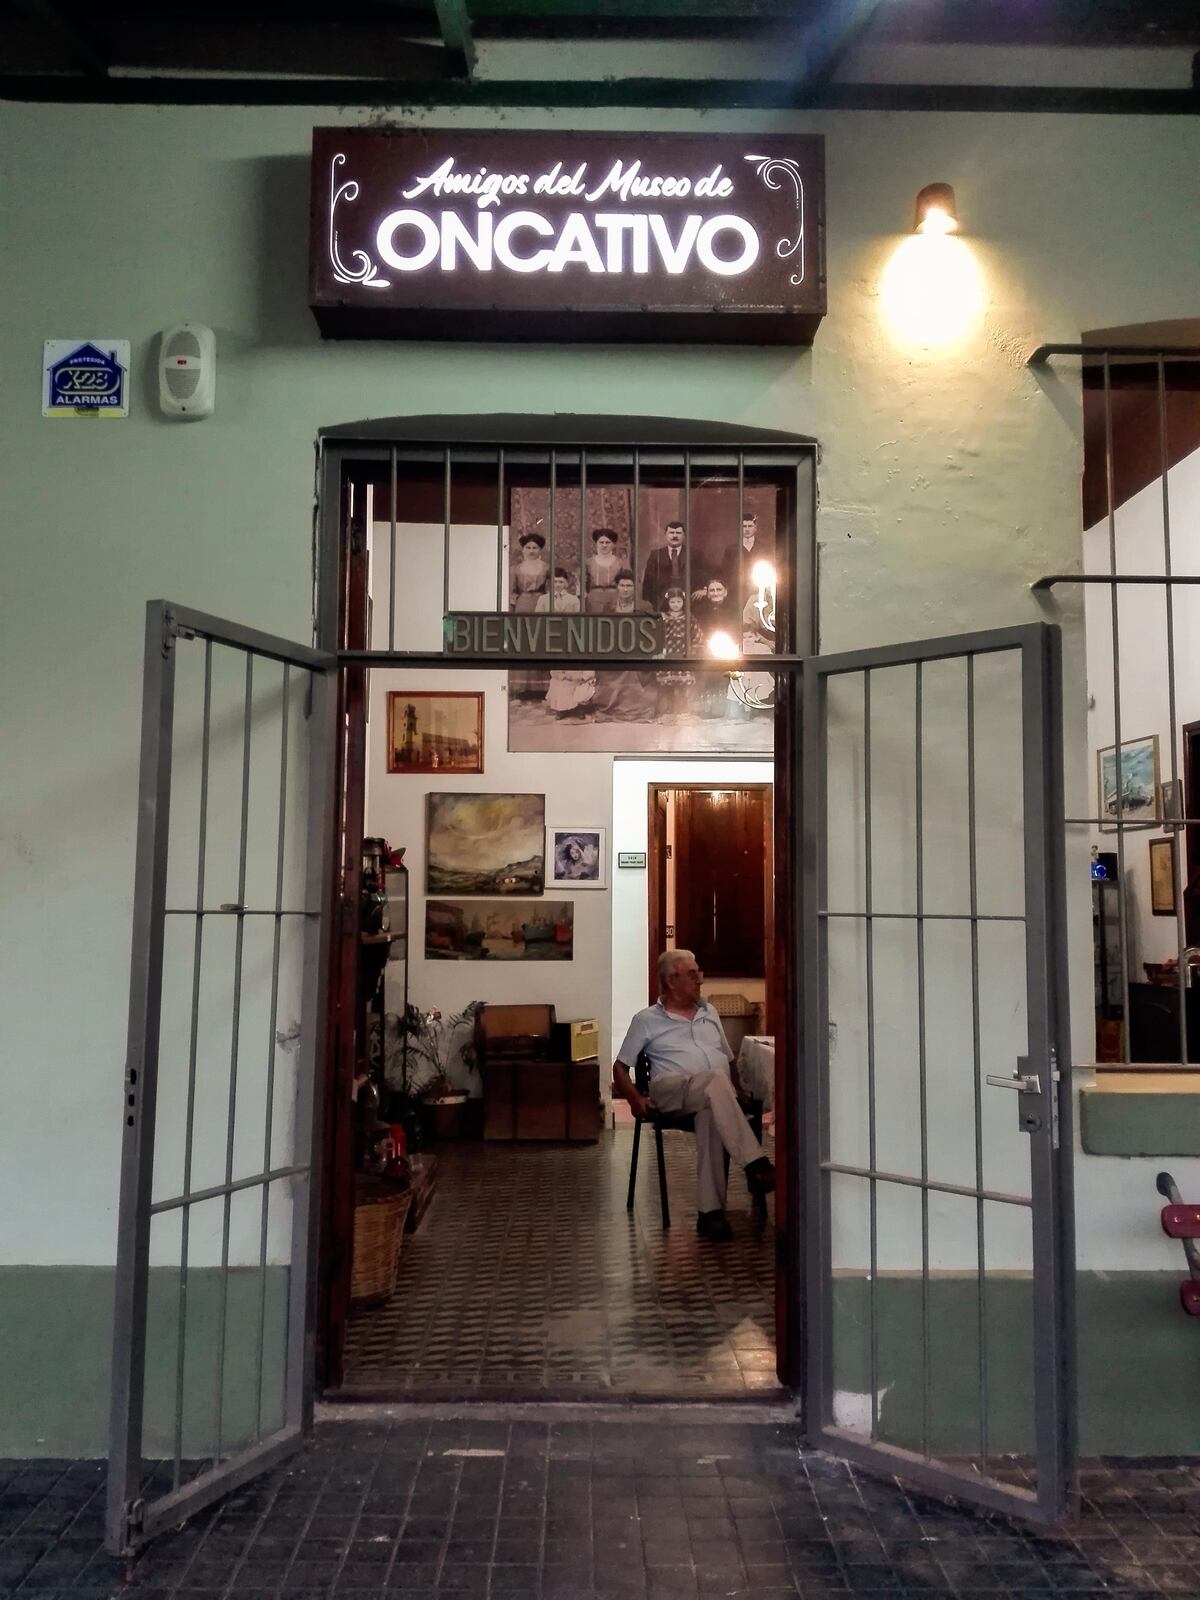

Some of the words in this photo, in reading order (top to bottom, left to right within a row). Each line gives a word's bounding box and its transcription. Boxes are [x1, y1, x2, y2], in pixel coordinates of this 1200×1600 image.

[403, 157, 529, 209] Amigos
[532, 162, 587, 197] del
[585, 159, 691, 202] Museo
[693, 164, 734, 198] de
[376, 209, 760, 276] ONCATIVO
[56, 395, 118, 404] ALARMAS
[453, 616, 657, 654] BIENVENIDOS
